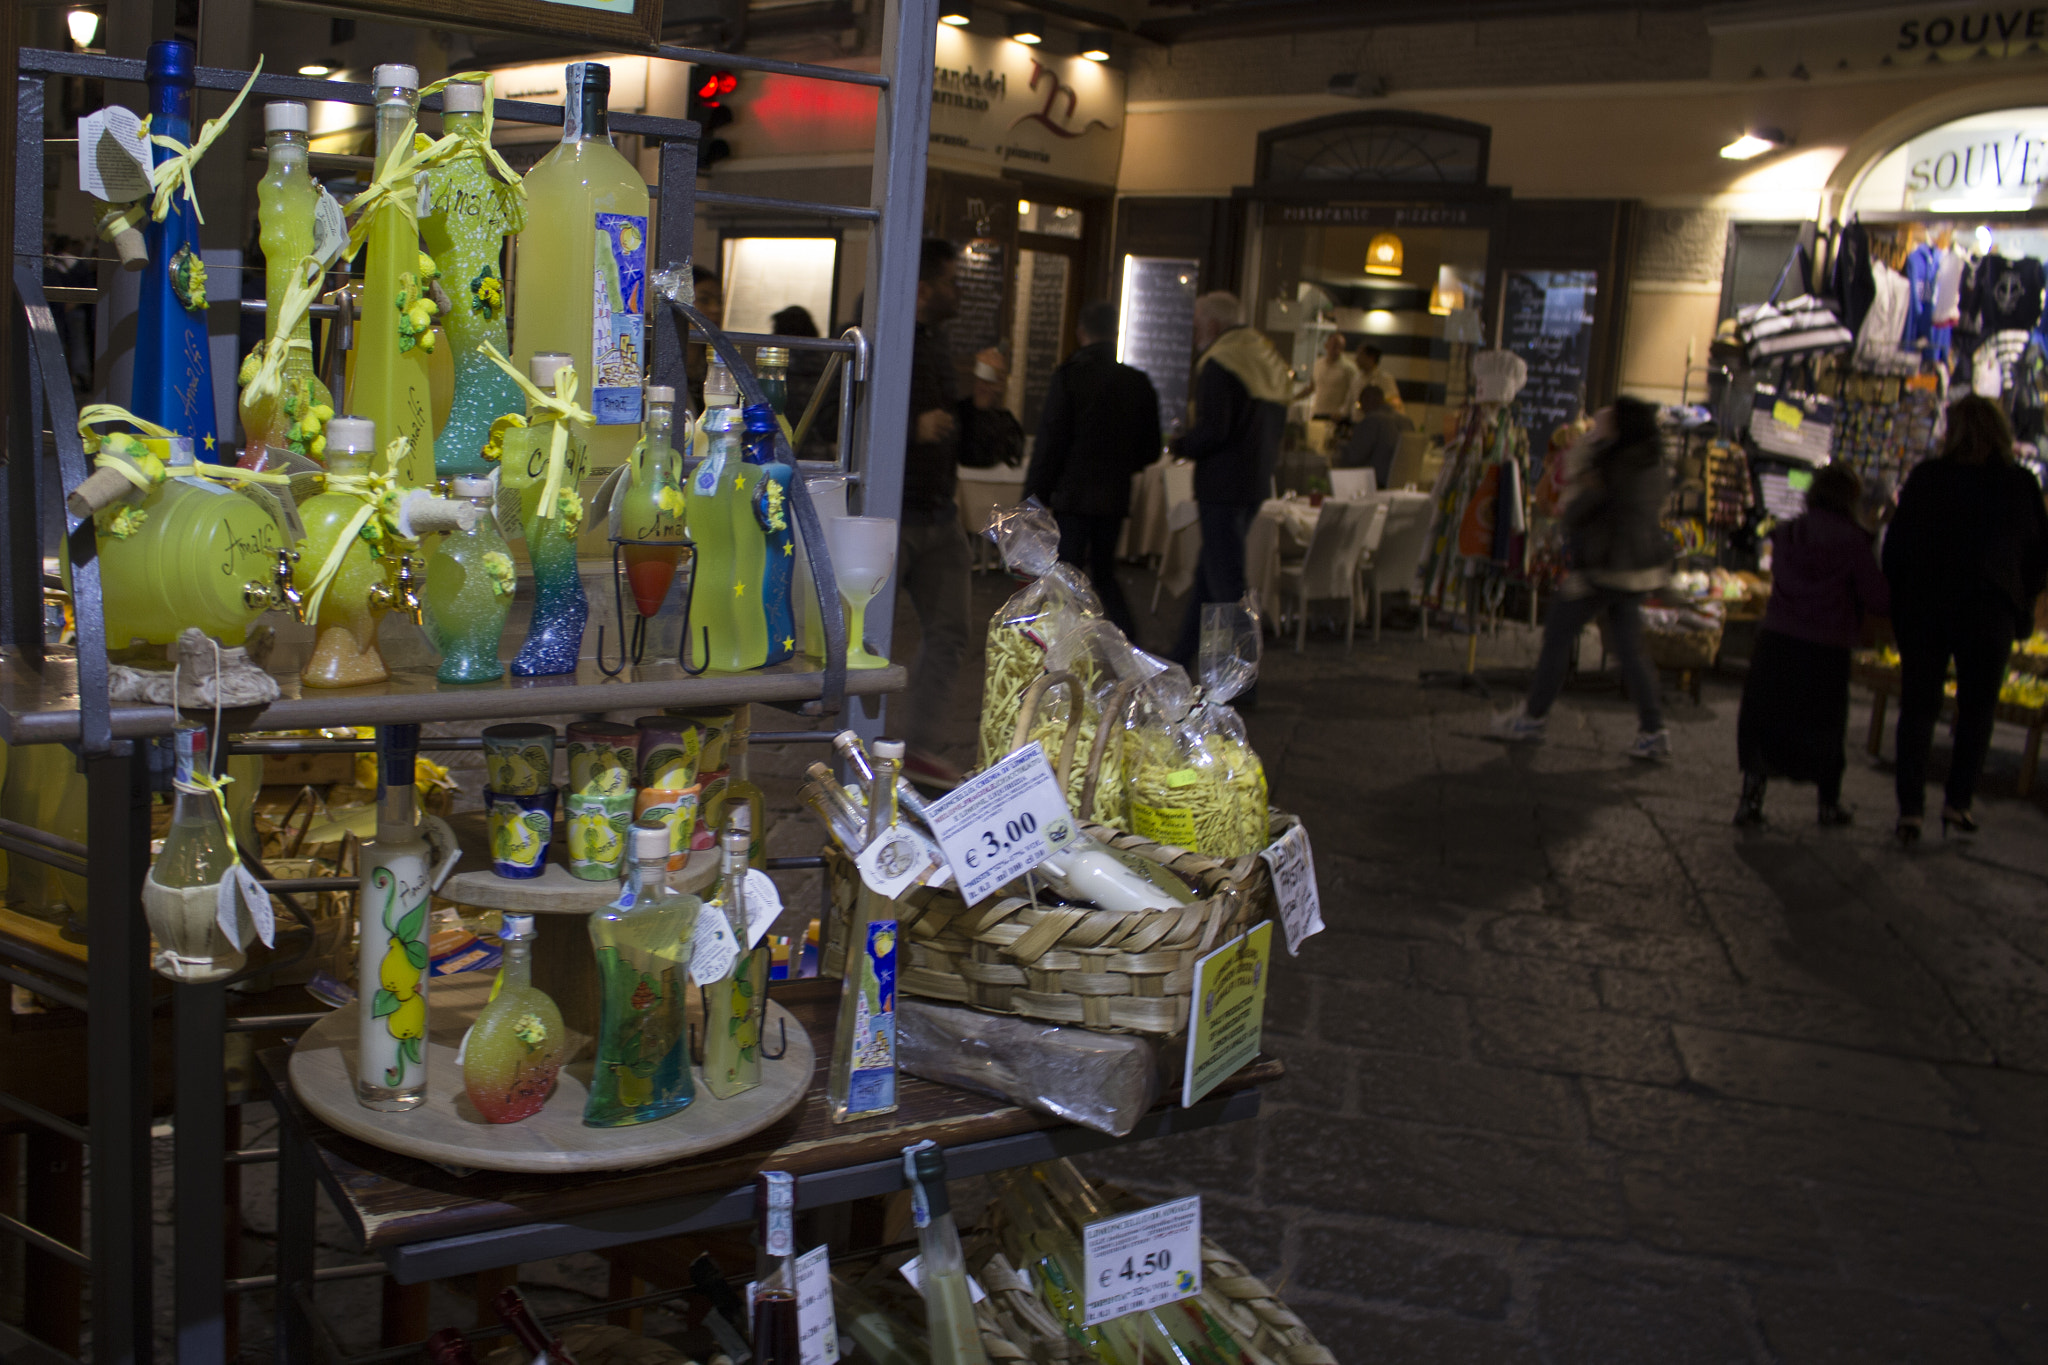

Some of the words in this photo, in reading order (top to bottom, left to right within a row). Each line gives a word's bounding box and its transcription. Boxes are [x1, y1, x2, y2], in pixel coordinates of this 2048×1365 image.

[1897, 8, 2047, 50] SOUVE
[1907, 130, 2047, 191] SOUVE
[1284, 206, 1369, 222] ristorante
[1394, 208, 1467, 229] pizzeria
[965, 848, 980, 868] €
[981, 811, 1037, 858] 3,00
[1099, 1268, 1113, 1287] €
[1119, 1249, 1172, 1283] 4,50
